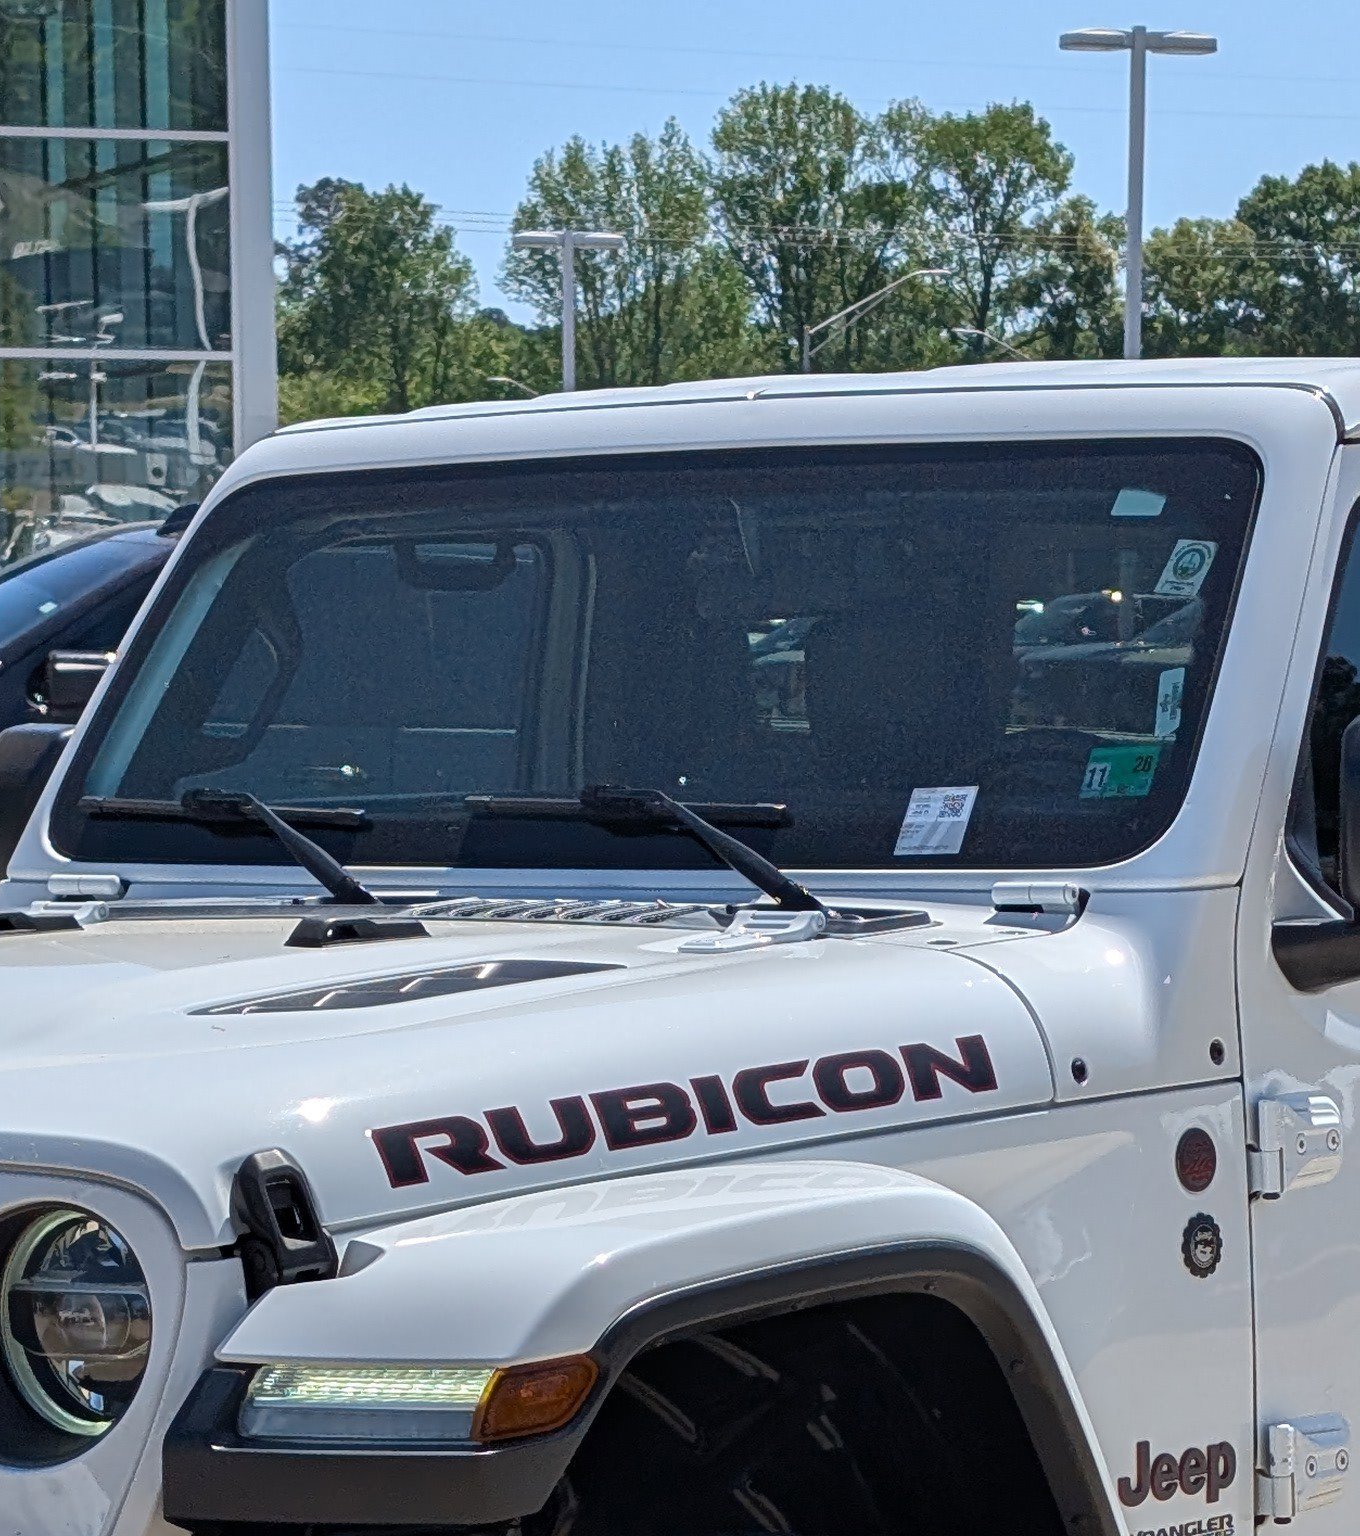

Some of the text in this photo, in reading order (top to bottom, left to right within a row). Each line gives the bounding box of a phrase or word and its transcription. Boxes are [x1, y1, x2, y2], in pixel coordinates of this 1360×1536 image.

[1086, 766, 1109, 789] 11
[371, 1034, 998, 1189] RUBICON
[1117, 1440, 1237, 1507] Jeep
